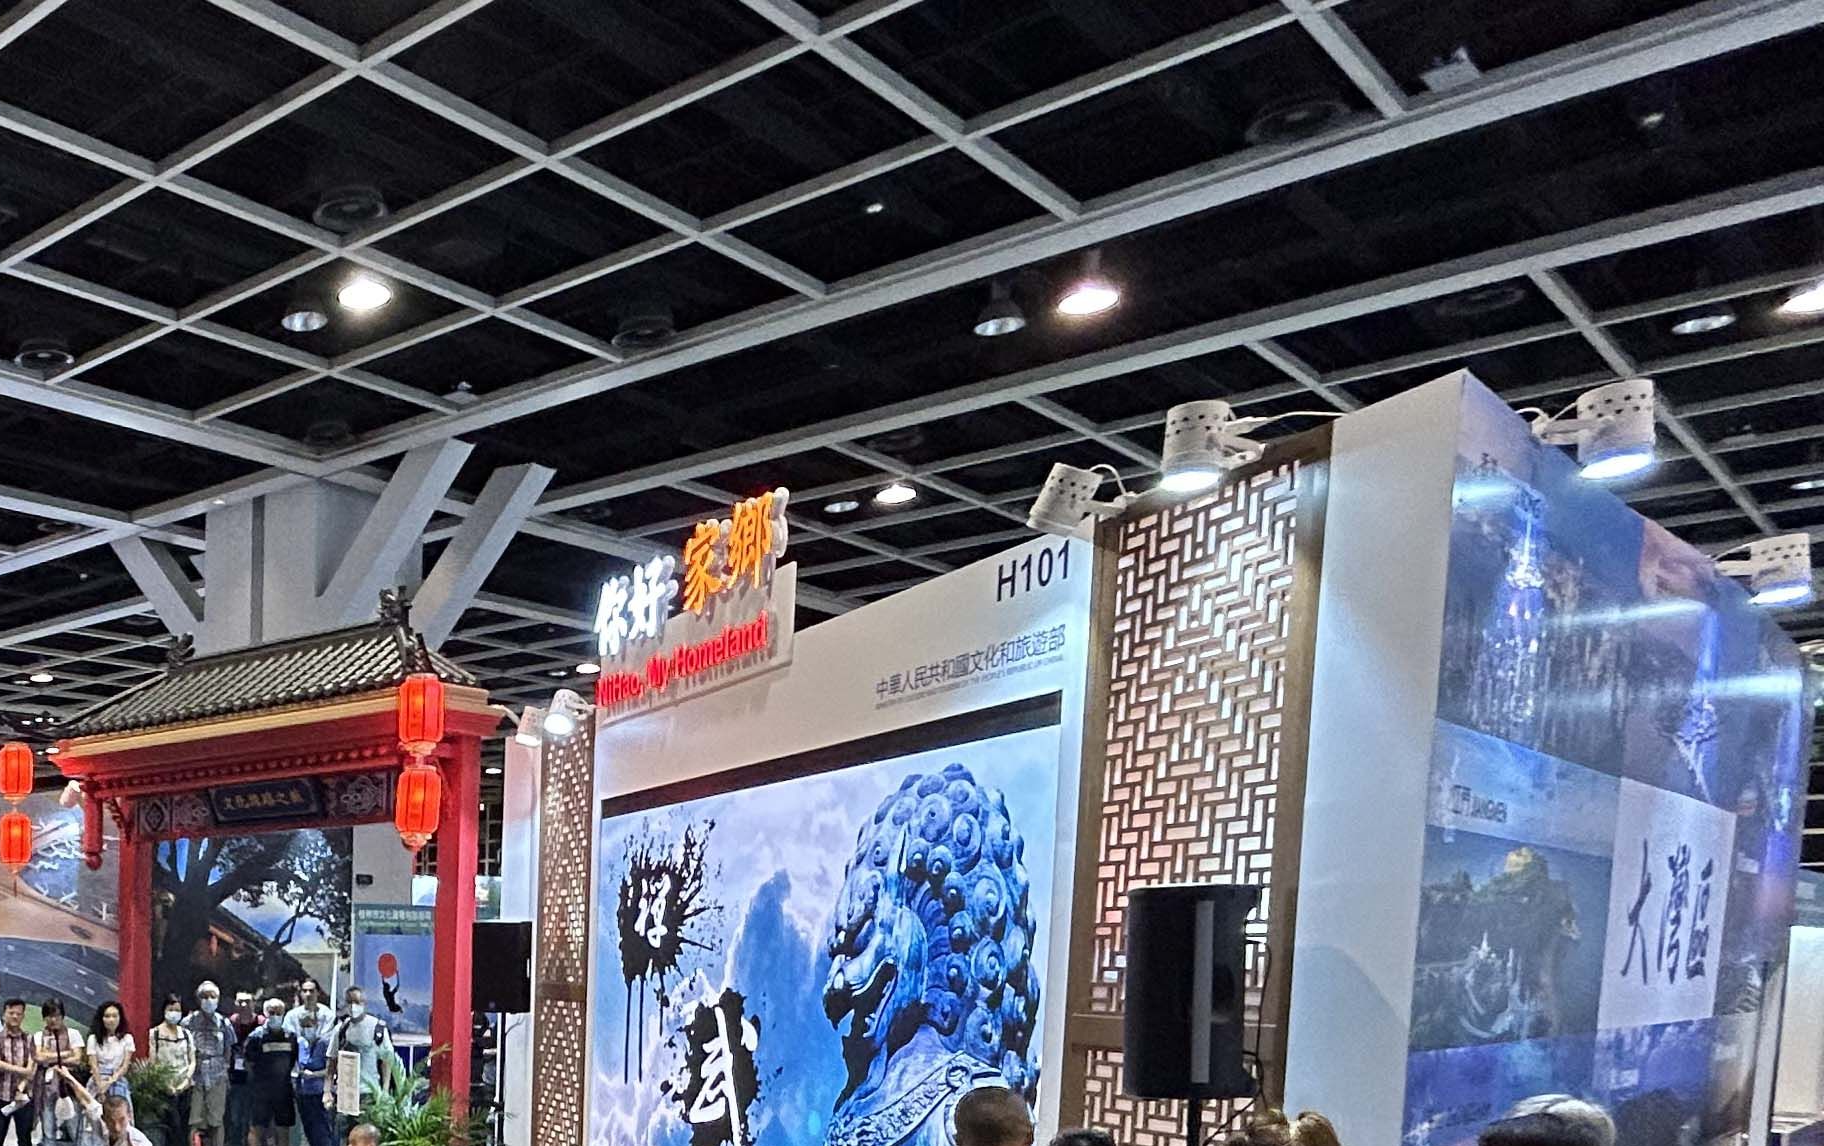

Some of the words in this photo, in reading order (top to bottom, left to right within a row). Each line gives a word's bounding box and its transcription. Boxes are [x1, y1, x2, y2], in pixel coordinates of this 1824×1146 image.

[594, 555, 666, 656] 你好
[683, 491, 774, 615] 家鄉
[997, 540, 1070, 602] H101
[646, 653, 675, 693] My
[675, 609, 768, 677] Homeland
[876, 624, 1066, 699] 中華人民共和國文化和旅遊部
[1620, 837, 1714, 985] 大灣區
